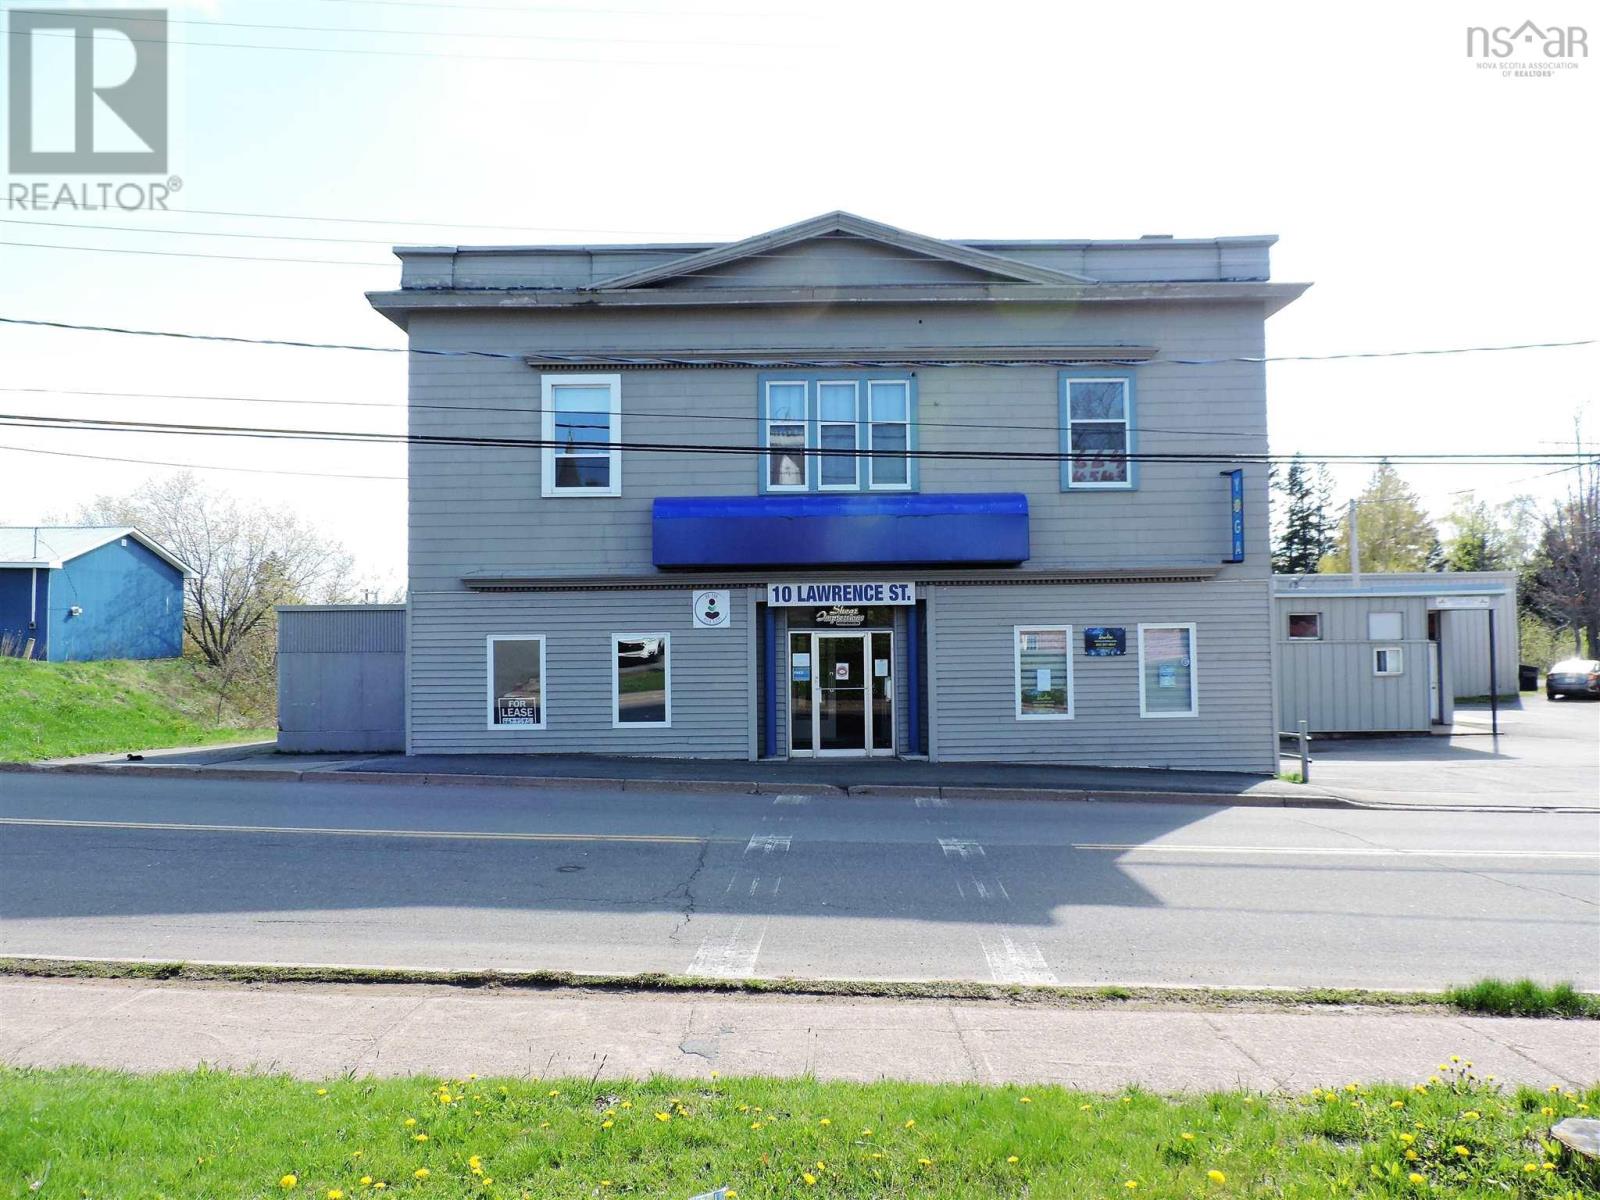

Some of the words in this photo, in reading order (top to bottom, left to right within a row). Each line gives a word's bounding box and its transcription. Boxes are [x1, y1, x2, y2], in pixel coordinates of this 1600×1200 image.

[772, 586, 792, 602] 10
[797, 584, 884, 603] LAWRENCE
[889, 584, 911, 601] ST.
[502, 708, 533, 716] LEASE
